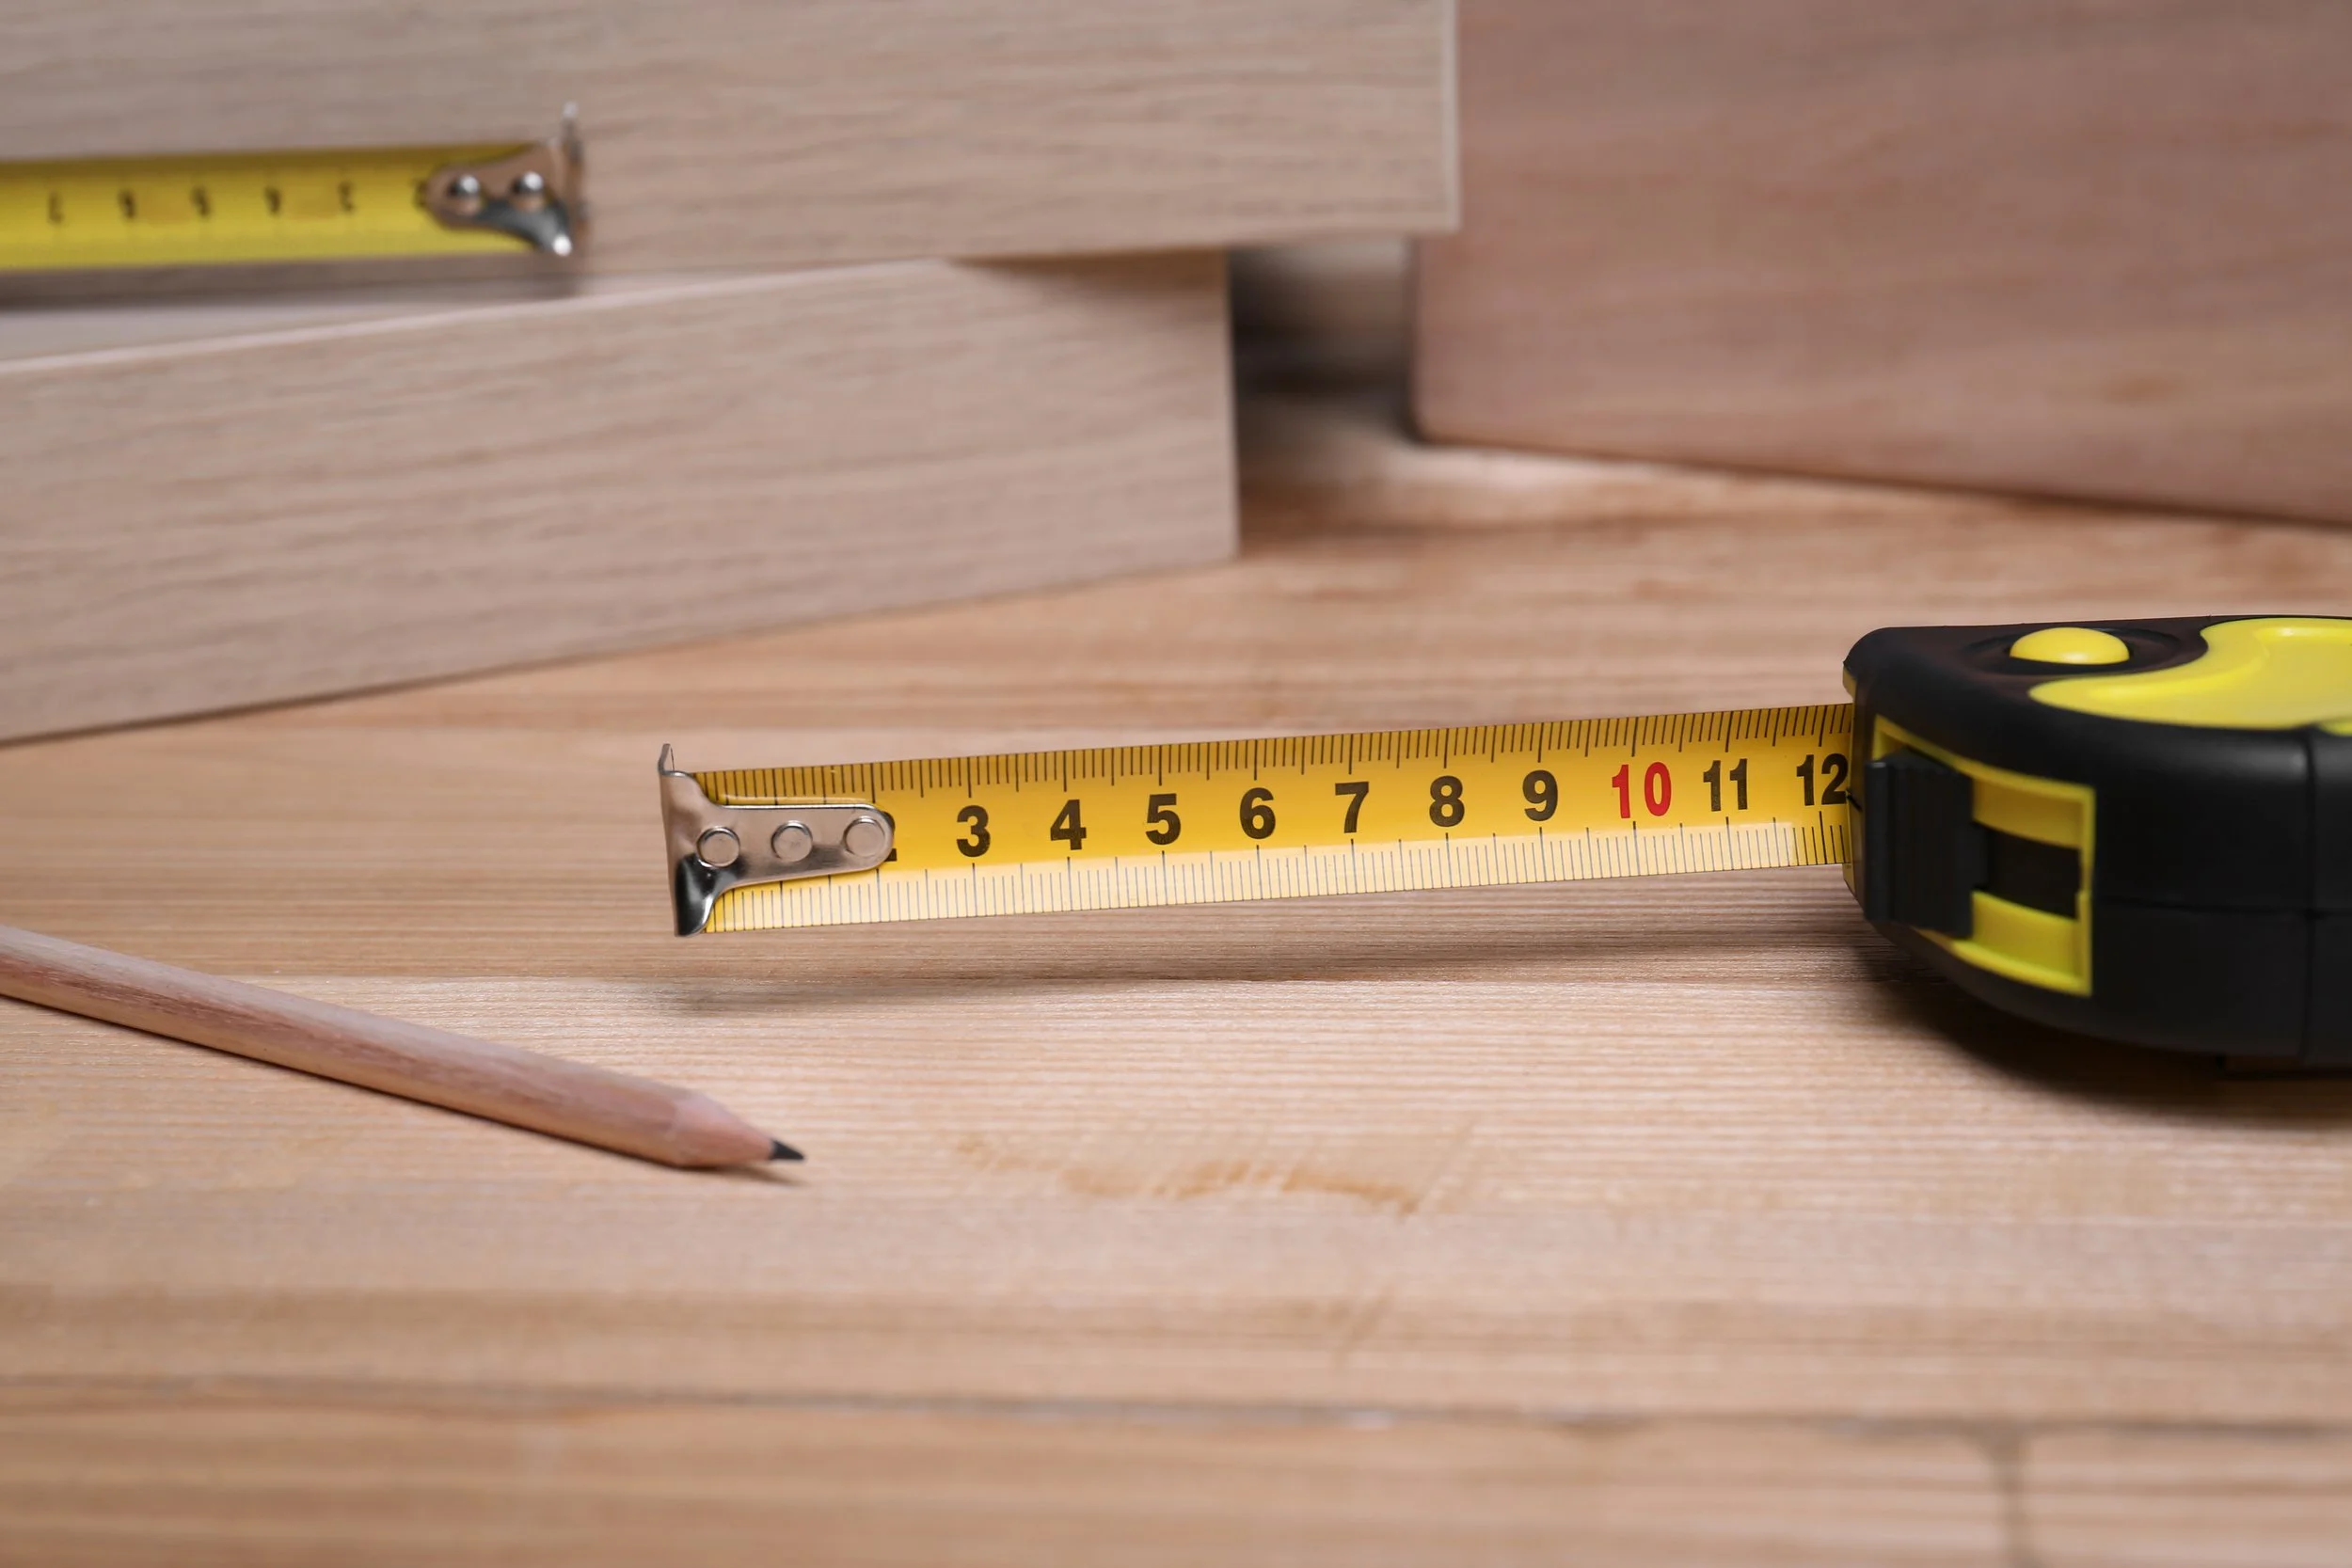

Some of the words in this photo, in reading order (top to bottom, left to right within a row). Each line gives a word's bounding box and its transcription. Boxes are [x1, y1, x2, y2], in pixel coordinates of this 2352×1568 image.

[956, 804, 991, 858] 3
[1050, 799, 1087, 850] 4
[1145, 793, 1182, 845] 5
[1239, 787, 1276, 840] 6
[1334, 781, 1370, 833] 7
[1429, 775, 1465, 827] 8
[1522, 769, 1559, 821] 9
[1612, 761, 1672, 818] 10
[1703, 757, 1748, 811] 11
[1796, 752, 1849, 806] 12
